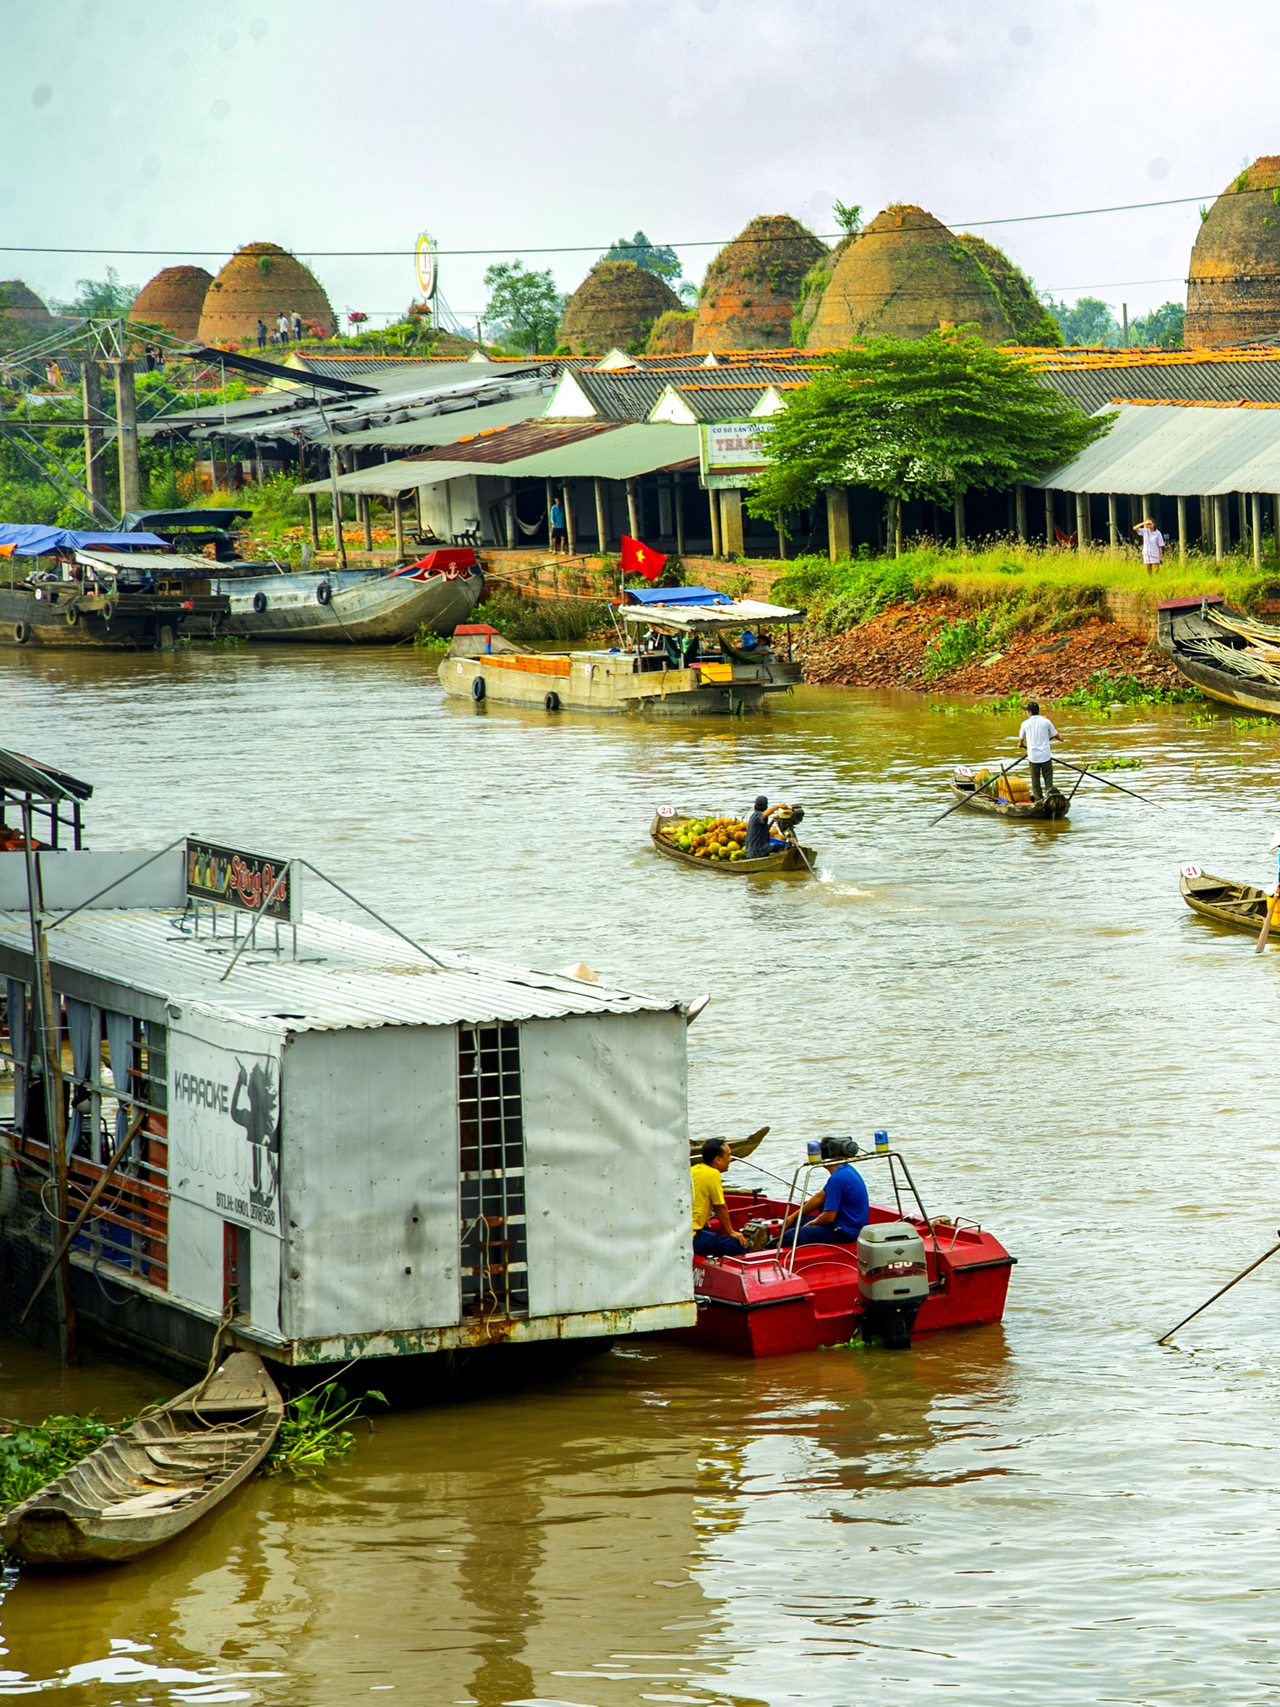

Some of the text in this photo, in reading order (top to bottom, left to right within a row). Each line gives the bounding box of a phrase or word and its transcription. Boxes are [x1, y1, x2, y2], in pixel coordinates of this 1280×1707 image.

[1185, 866, 1198, 876] 21
[175, 1070, 229, 1113] KARAOKE
[234, 1198, 250, 1218] 0901
